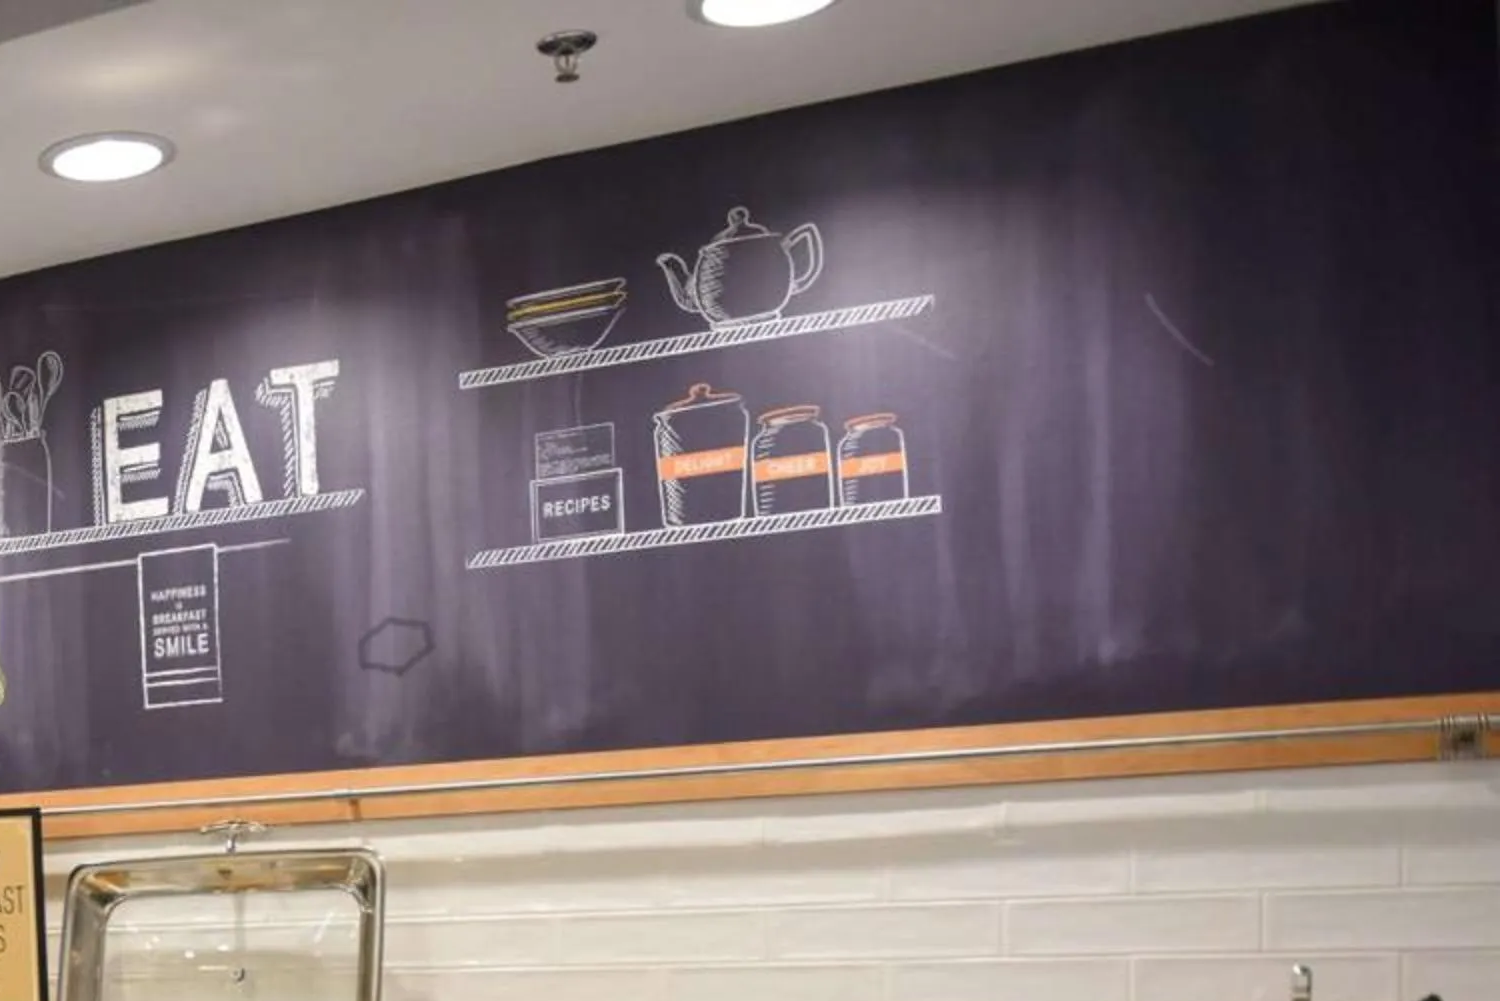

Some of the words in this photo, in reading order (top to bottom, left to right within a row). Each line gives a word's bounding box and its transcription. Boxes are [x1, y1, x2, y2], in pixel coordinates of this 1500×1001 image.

[98, 358, 340, 525] EAT
[543, 495, 611, 518] RECIPES
[150, 585, 207, 602] HAPPINESS
[152, 608, 207, 625] BREAKFAST
[154, 633, 211, 658] SMILE
